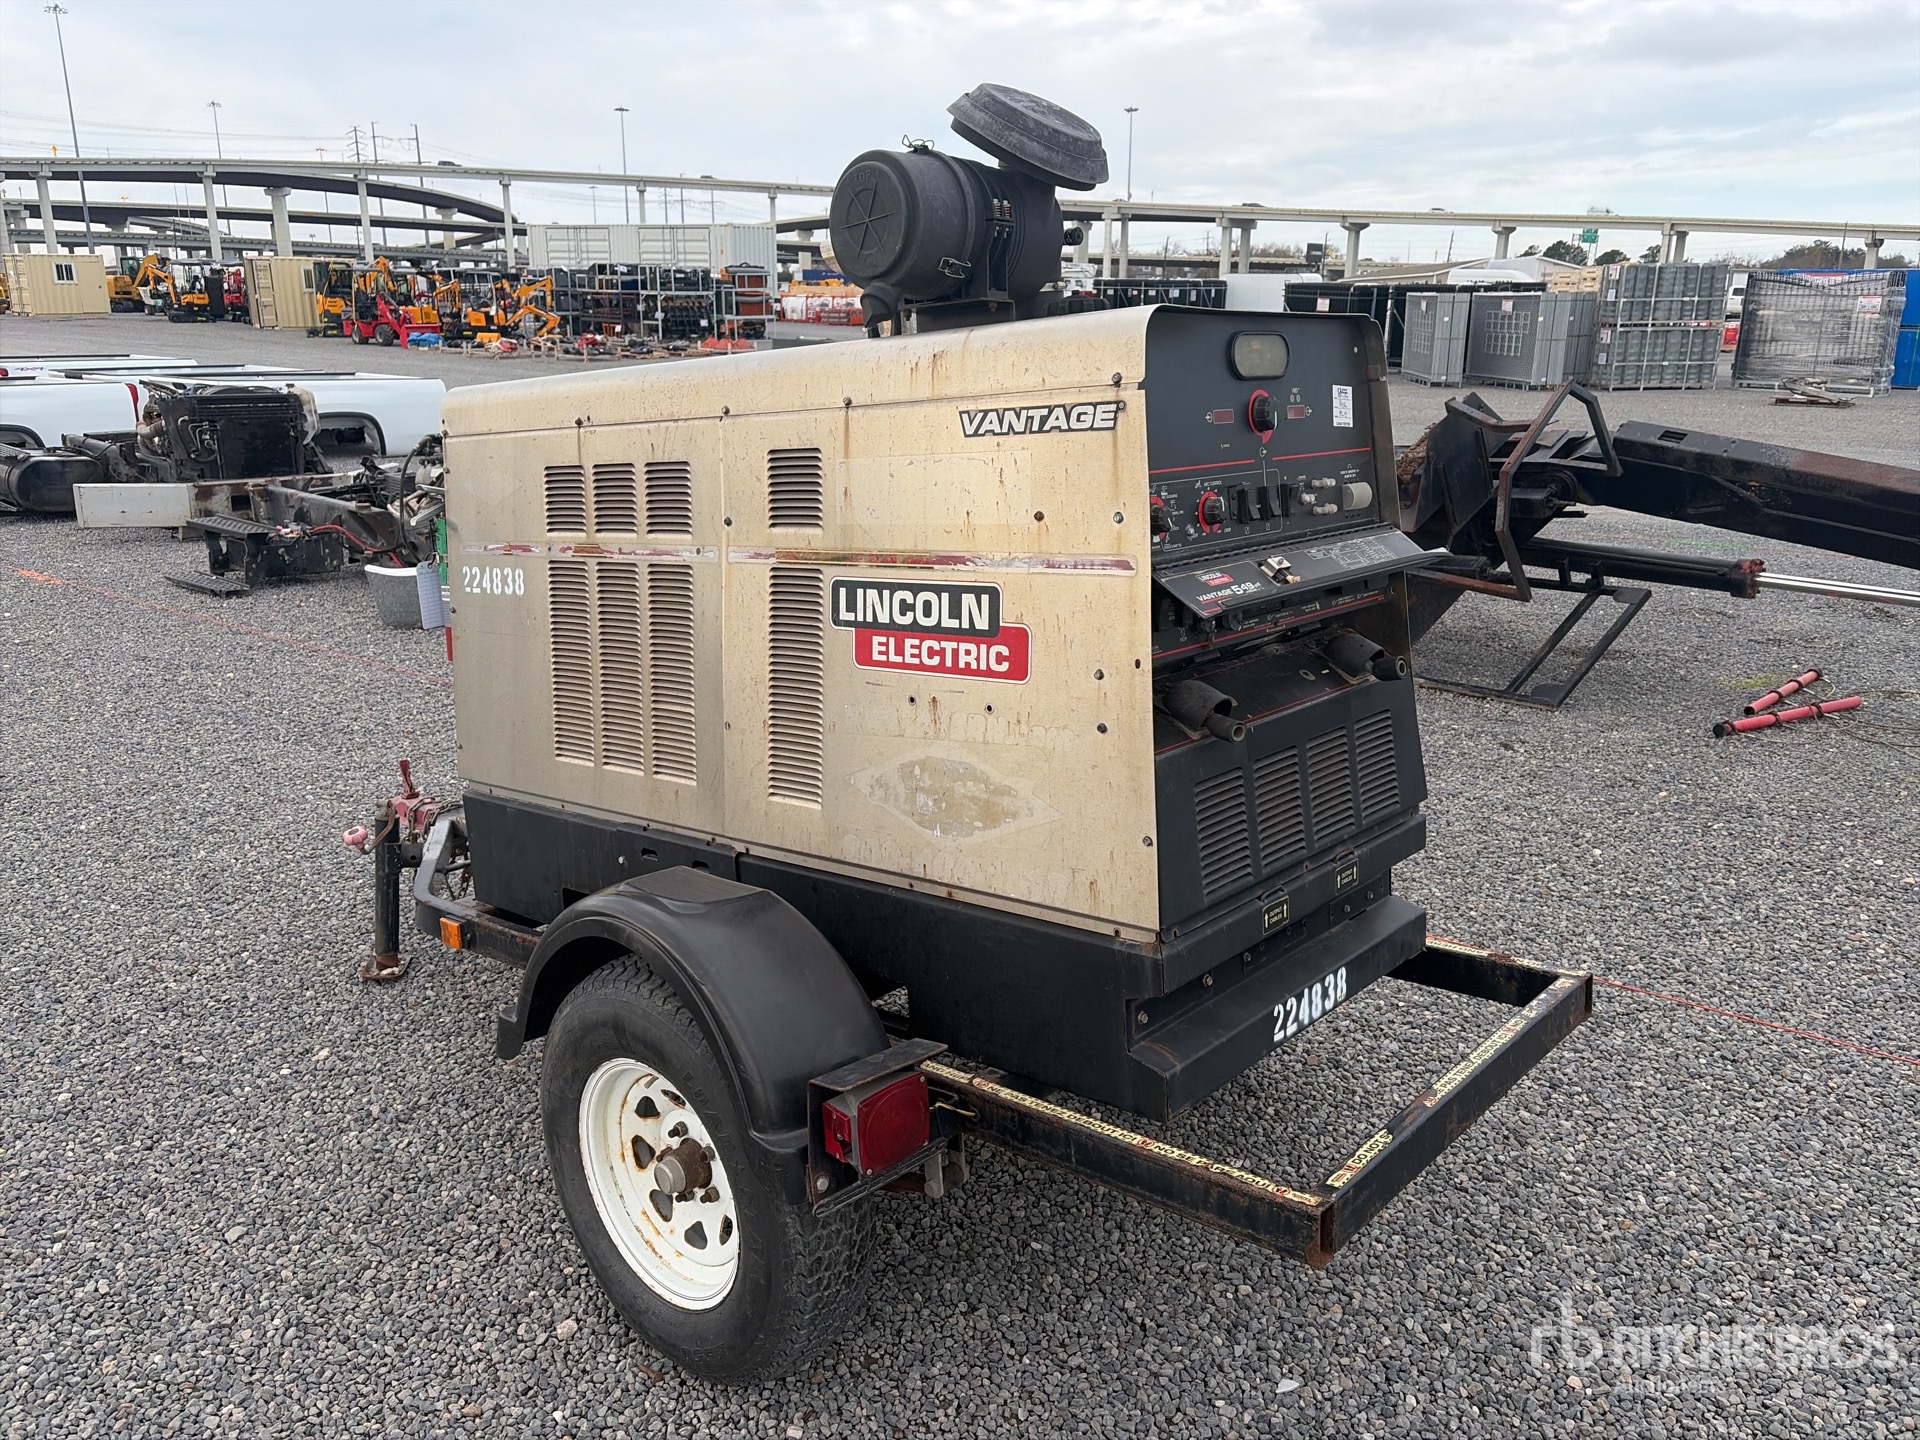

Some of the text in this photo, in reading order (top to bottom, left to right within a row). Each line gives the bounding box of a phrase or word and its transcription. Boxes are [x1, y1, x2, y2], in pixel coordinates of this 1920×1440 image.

[853, 169, 872, 183] TOP
[960, 402, 1119, 437] VANTAGE
[462, 565, 525, 596] 224838
[1198, 571, 1223, 582] LINCOLN
[838, 587, 990, 631] LINCOLN
[1196, 588, 1234, 602] VANTAGE
[871, 635, 1010, 672] ELECTRIC
[1341, 867, 1353, 879] OUTPUT
[1341, 874, 1353, 885] CABLES
[1269, 906, 1283, 918] OUTPUT
[1269, 913, 1283, 924] CABLES
[1273, 966, 1347, 1042] 224838
[1440, 1076, 1458, 1088] PAS
[1472, 1039, 1501, 1060] DEBOUT
[987, 1086, 1137, 1141] NE PAS TENEZ DEBOUT ICI
[1352, 1153, 1367, 1165] DO
[1367, 1139, 1382, 1155] NOT
[1154, 1145, 1175, 1155] NO
[1176, 1153, 1197, 1163] SE
[1236, 1174, 1273, 1190] AQUI
